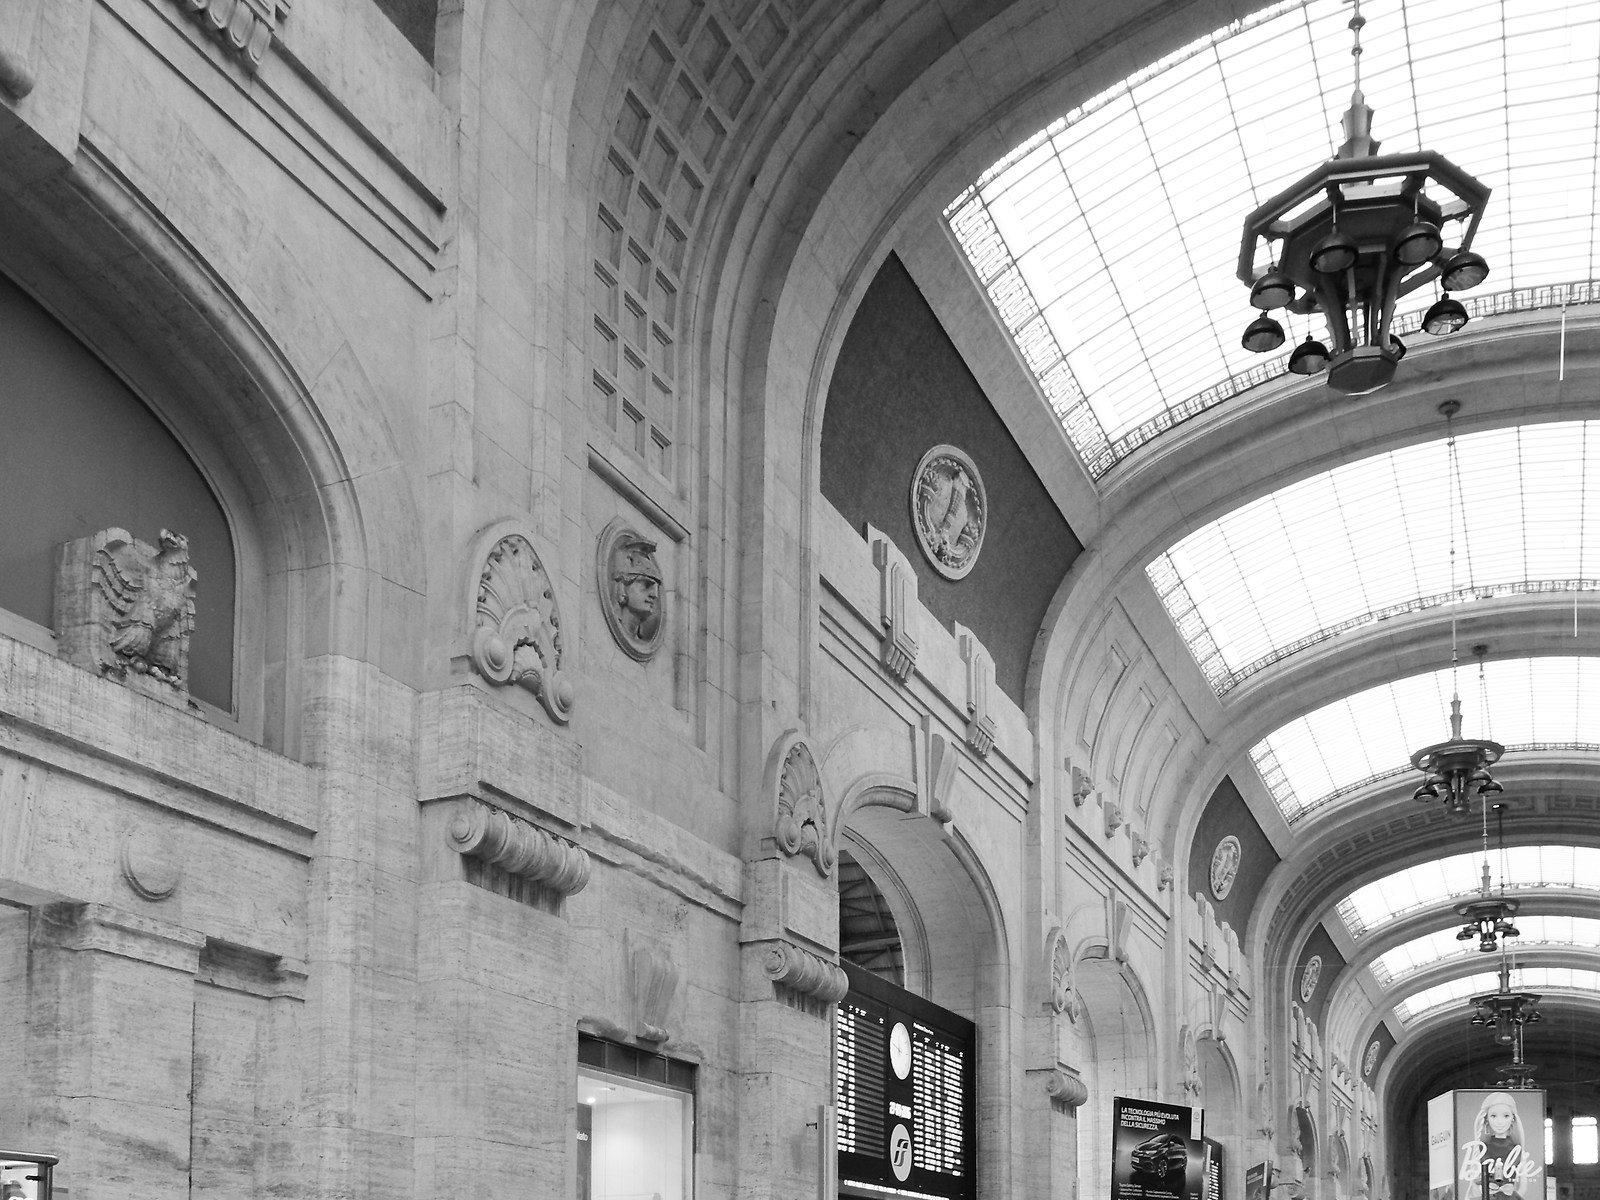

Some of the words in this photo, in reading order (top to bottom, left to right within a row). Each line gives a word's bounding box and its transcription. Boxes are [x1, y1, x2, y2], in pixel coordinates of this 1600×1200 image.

[1127, 1107, 1153, 1117] TECNOLOGIA
[1161, 1112, 1180, 1120] EVOLUTA
[1120, 1120, 1134, 1128] DELLA
[1121, 1114, 1143, 1122] INCONTRA
[1147, 1117, 1166, 1125] MASSIMO
